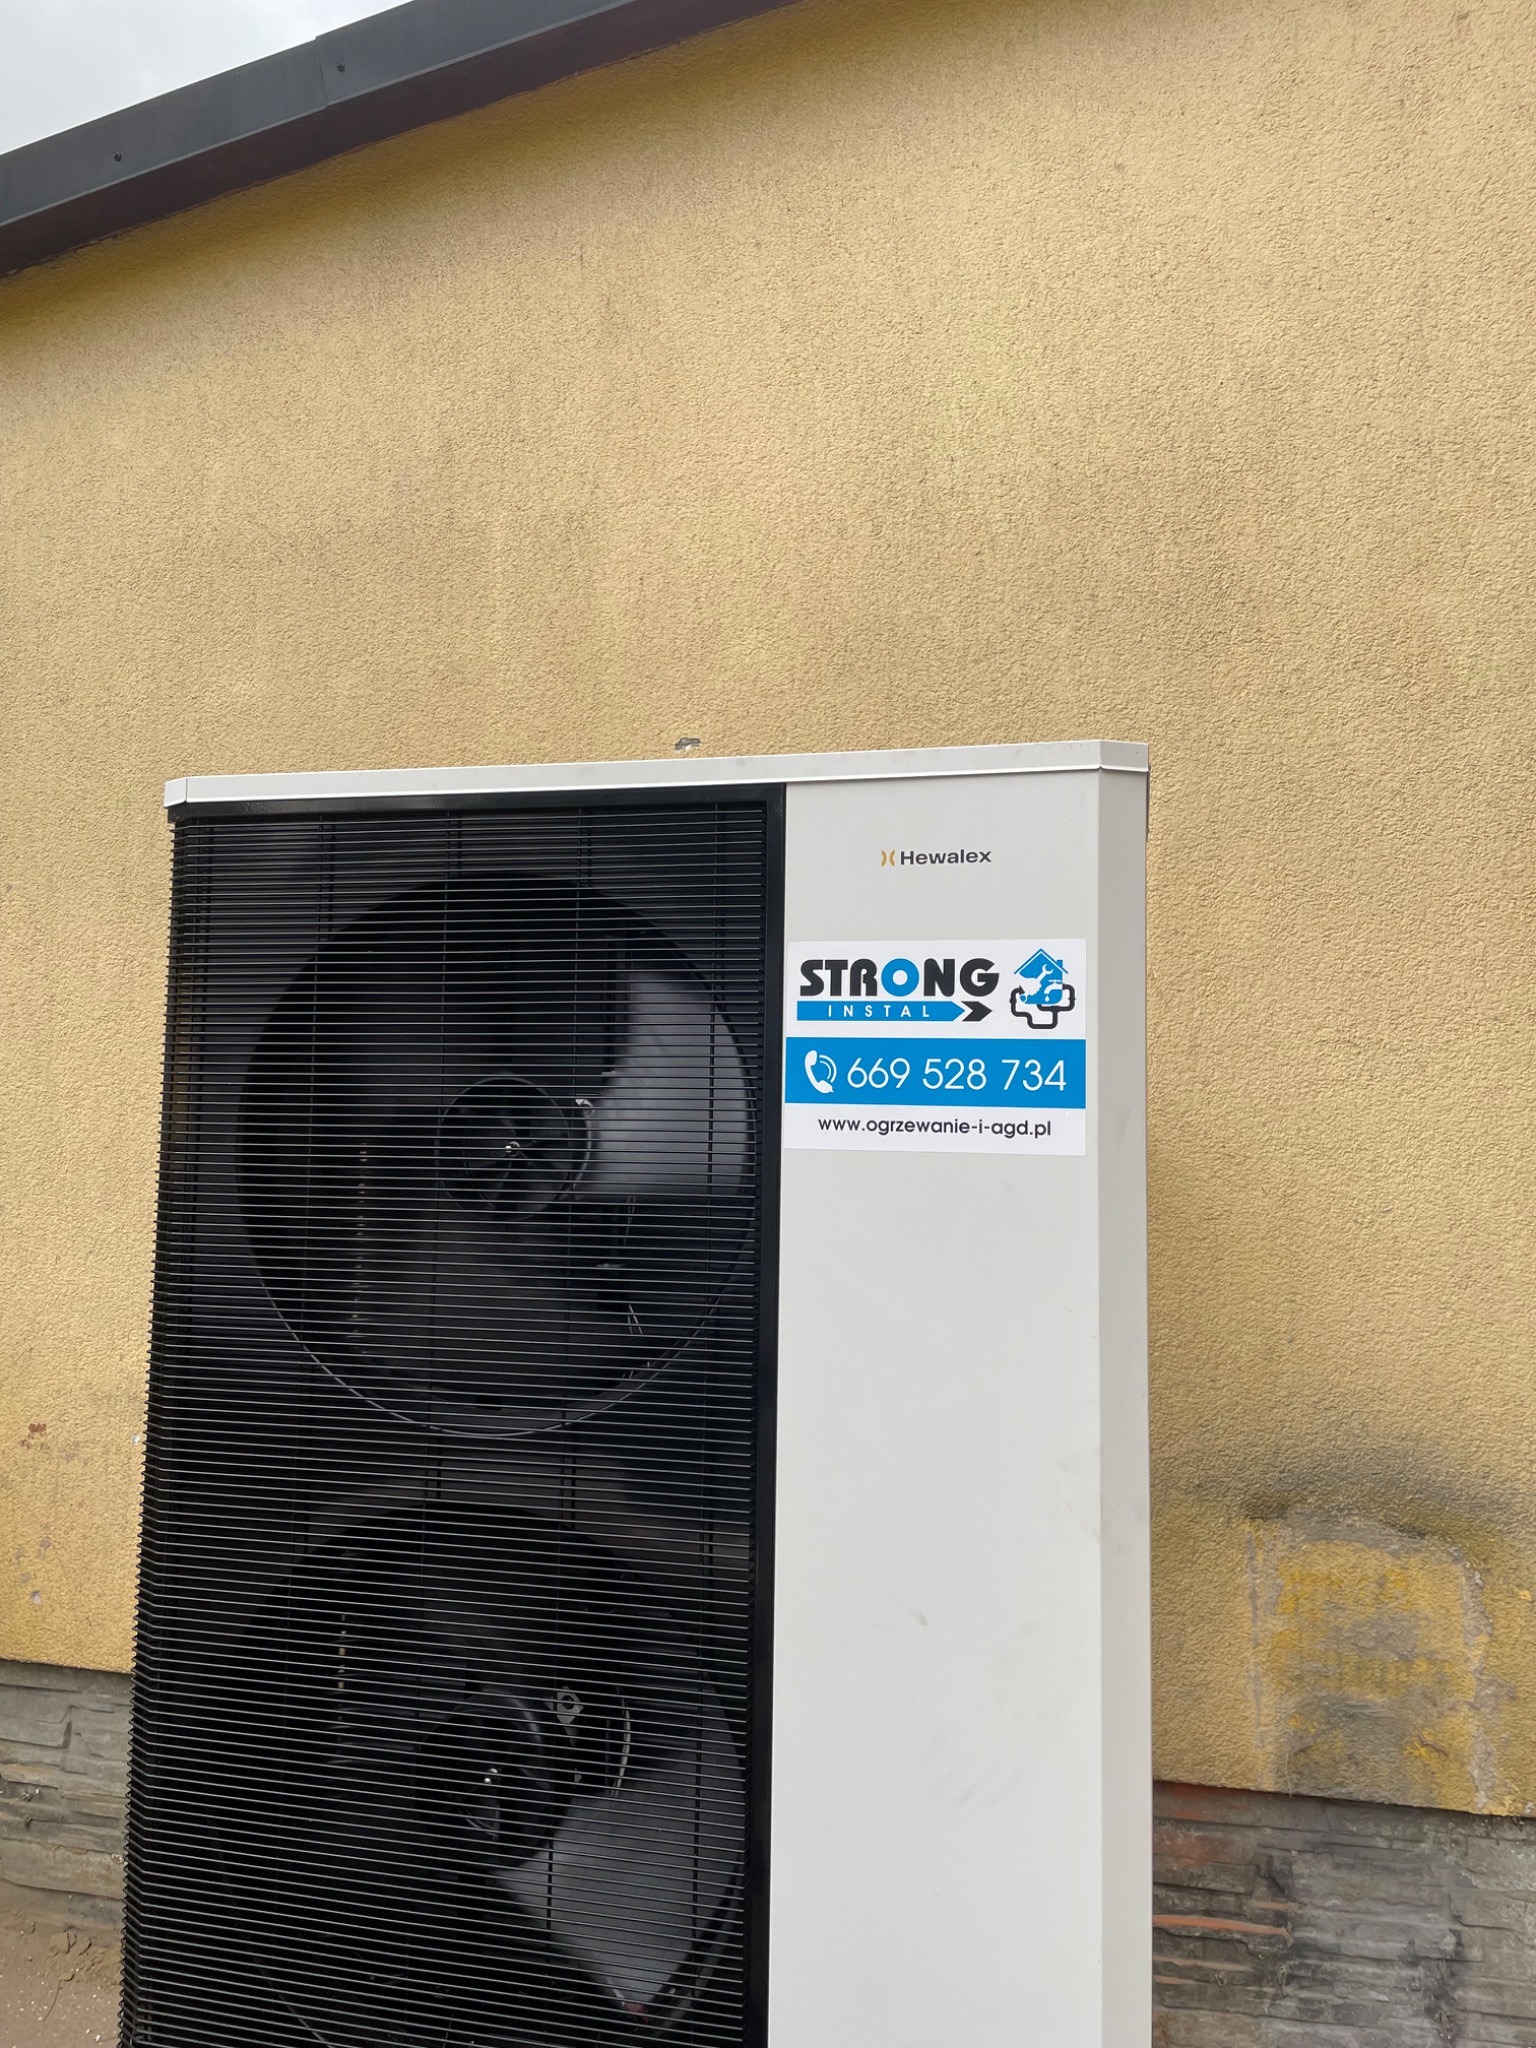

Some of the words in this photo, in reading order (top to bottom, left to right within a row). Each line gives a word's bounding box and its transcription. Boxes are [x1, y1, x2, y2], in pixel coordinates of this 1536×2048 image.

[900, 848, 992, 866] Hewalex
[799, 957, 1000, 997] STRONG
[828, 1004, 930, 1018] INSTAL
[847, 1057, 911, 1089] 669
[922, 1058, 987, 1090] 528
[1001, 1059, 1067, 1091] 734
[818, 1118, 1052, 1139] www.ogrzewanie-i-agd.pl
